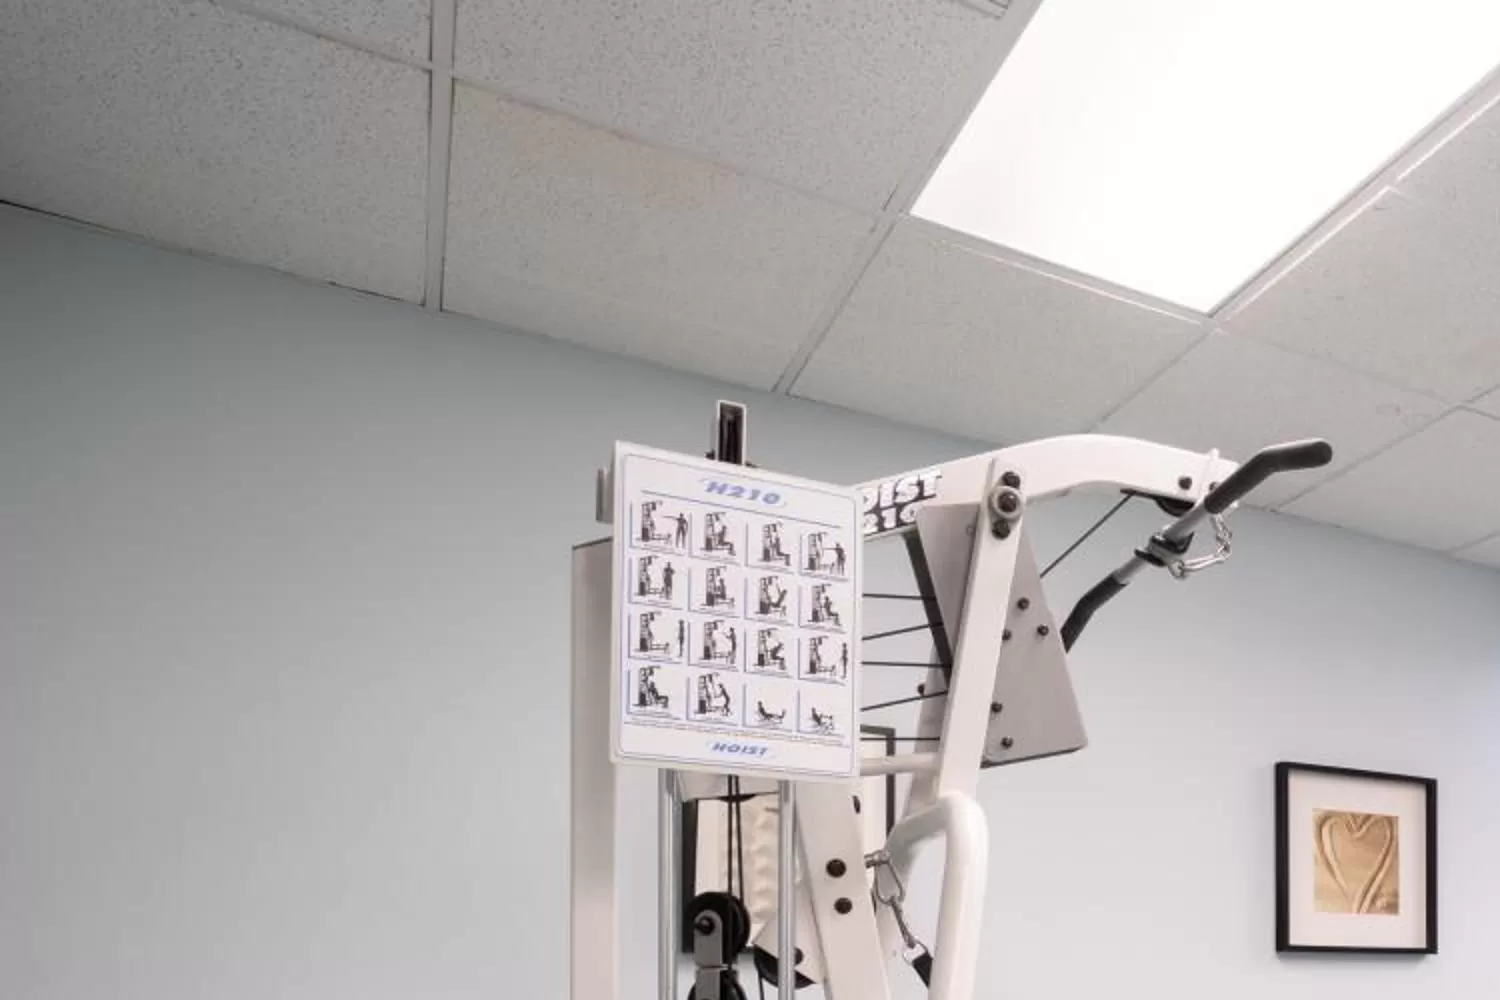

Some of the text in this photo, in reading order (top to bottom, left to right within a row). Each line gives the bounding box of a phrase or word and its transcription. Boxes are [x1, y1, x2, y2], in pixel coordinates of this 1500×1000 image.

[705, 481, 781, 505] H210
[863, 474, 942, 513] OIST
[712, 742, 768, 756] HOIST
